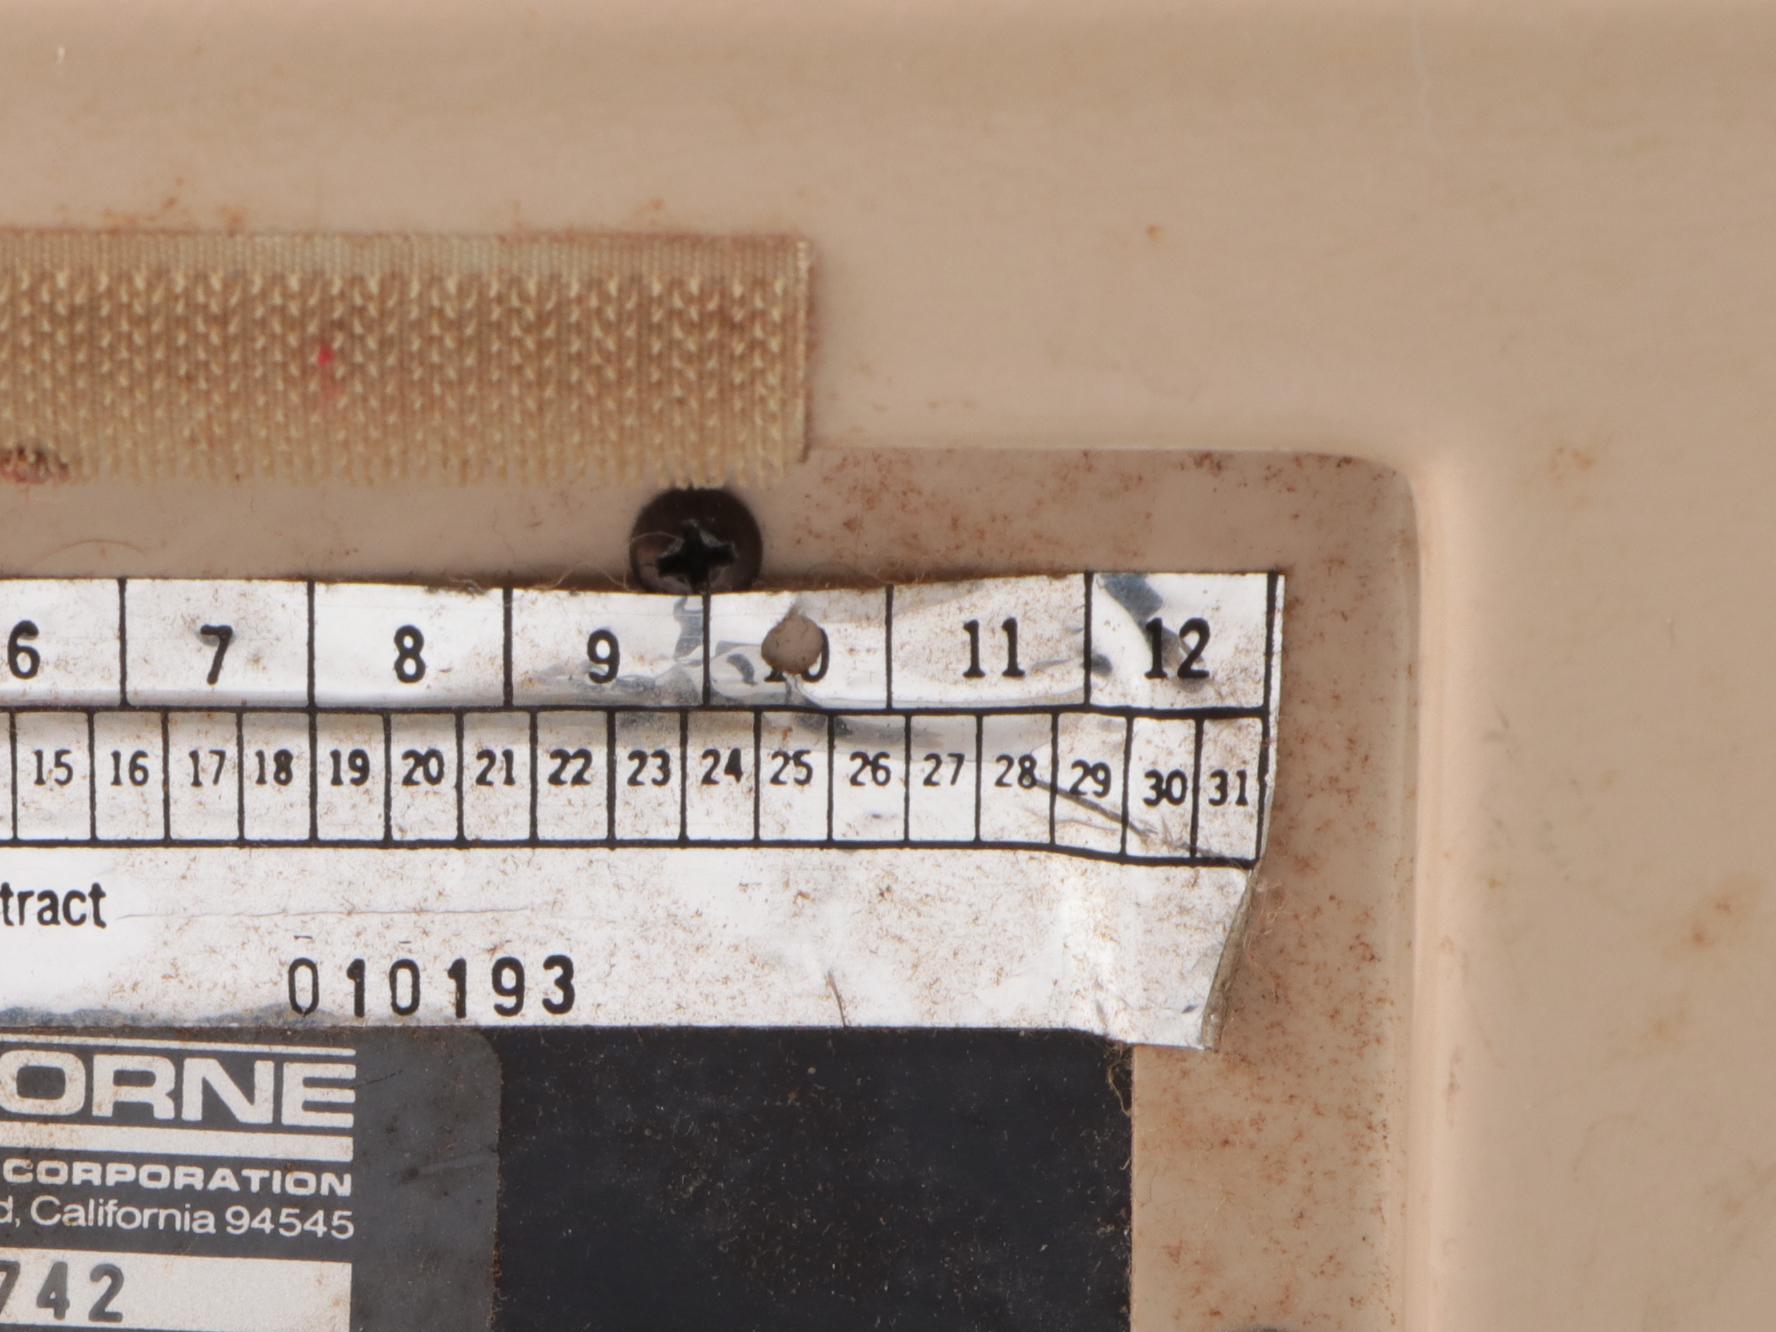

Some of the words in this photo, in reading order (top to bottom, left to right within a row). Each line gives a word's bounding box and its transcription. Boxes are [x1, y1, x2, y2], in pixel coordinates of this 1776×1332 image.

[7, 619, 43, 681] 6
[197, 624, 234, 686] 7
[392, 624, 427, 685] 8
[585, 626, 622, 685] 9
[764, 624, 830, 683] 0
[962, 616, 1025, 680] 11
[1143, 616, 1212, 682] 12
[33, 749, 76, 787] 15
[109, 750, 152, 787] 16
[188, 750, 227, 788] 17
[255, 750, 295, 786] 18
[329, 748, 371, 787] 19
[401, 749, 446, 786] 20
[474, 748, 516, 786] 21
[548, 748, 594, 786] 22
[626, 749, 672, 786] 23
[700, 748, 745, 785] 24
[769, 750, 815, 785] 25
[849, 752, 892, 788] 26
[922, 753, 965, 788] 27
[994, 754, 1039, 790] 28
[1069, 760, 1112, 798] 29
[1143, 769, 1188, 807] 30
[1208, 769, 1251, 808] 31
[287, 954, 577, 1018] 010193
[3, 1157, 353, 1198] CORPORATION
[30, 1195, 216, 1236] California
[225, 1205, 356, 1241] 94545
